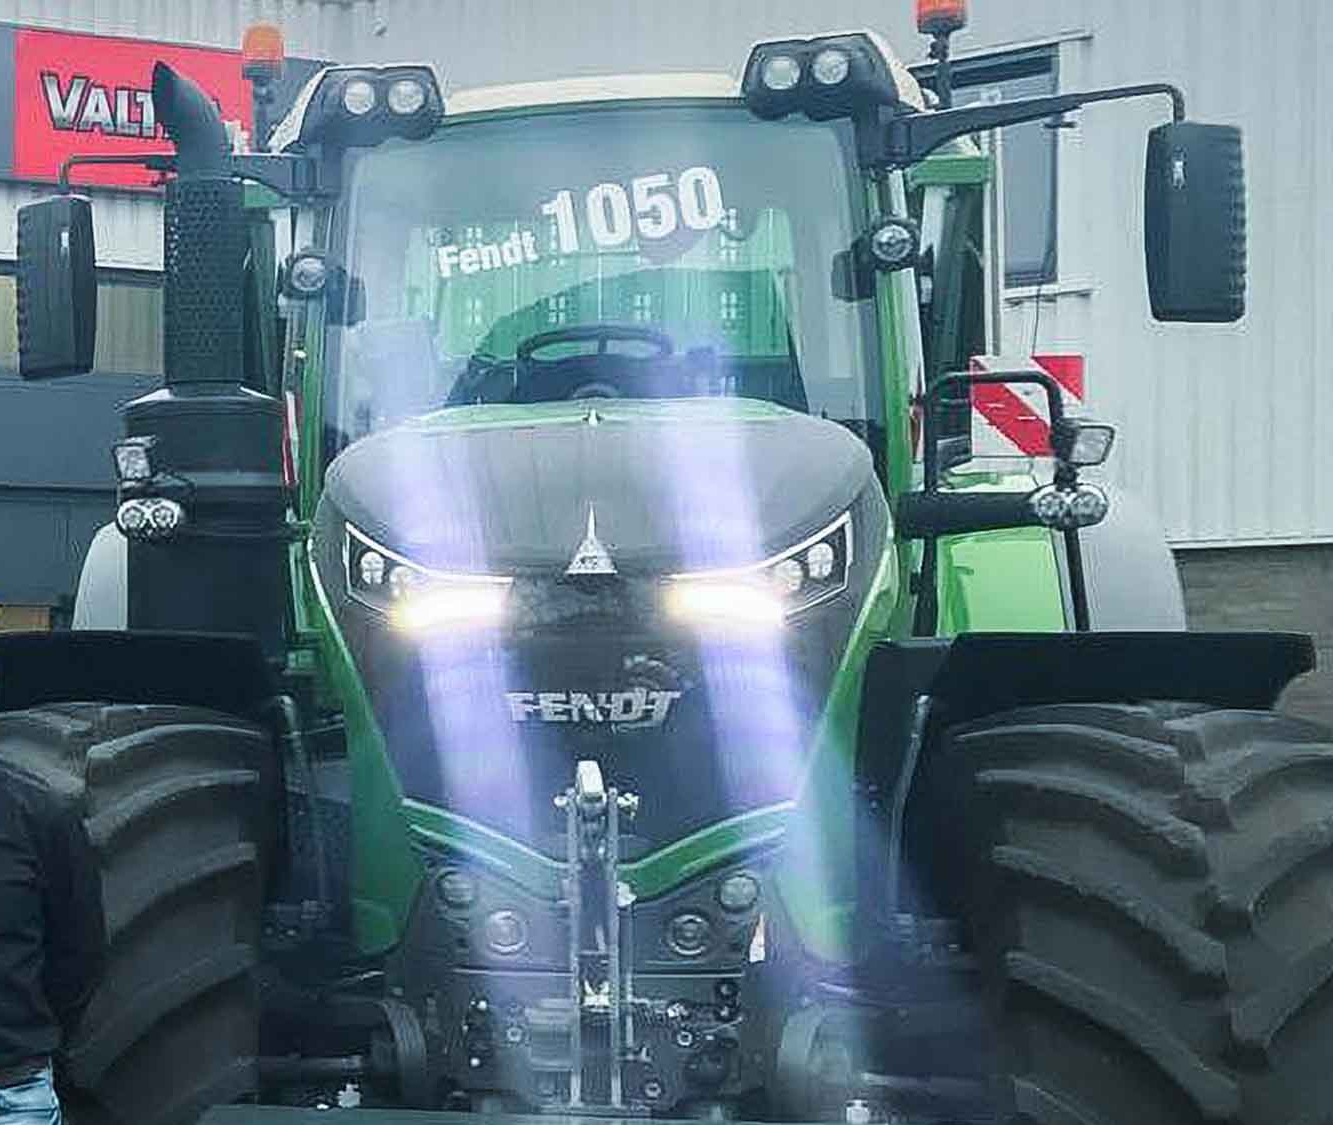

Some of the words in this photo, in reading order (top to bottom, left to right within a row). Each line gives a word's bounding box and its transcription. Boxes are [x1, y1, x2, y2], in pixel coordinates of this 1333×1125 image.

[39, 72, 159, 139] VALT
[436, 229, 537, 278] Fendt
[541, 166, 723, 254] 1050
[504, 690, 682, 724] FENDT
